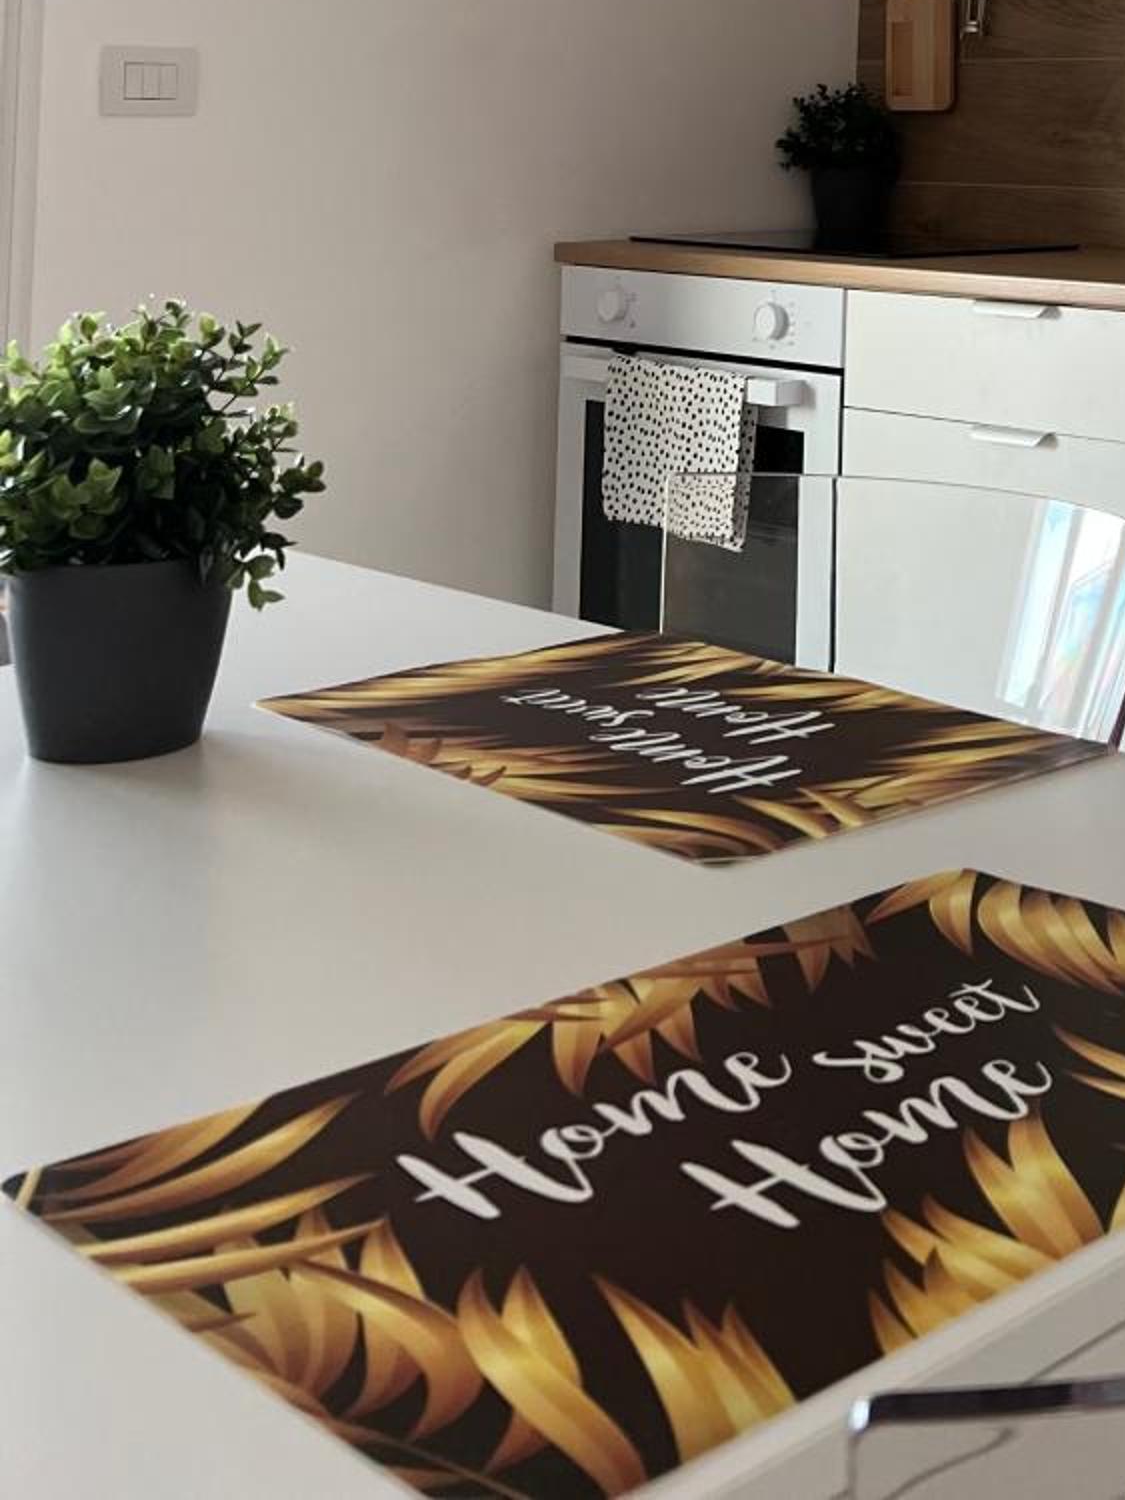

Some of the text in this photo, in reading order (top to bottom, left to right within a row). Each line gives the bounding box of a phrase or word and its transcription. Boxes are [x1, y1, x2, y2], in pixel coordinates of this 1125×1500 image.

[589, 728, 803, 793] Home
[636, 687, 836, 745] Home
[397, 979, 1041, 1219] Home sweet
[680, 1058, 1053, 1229] Home
